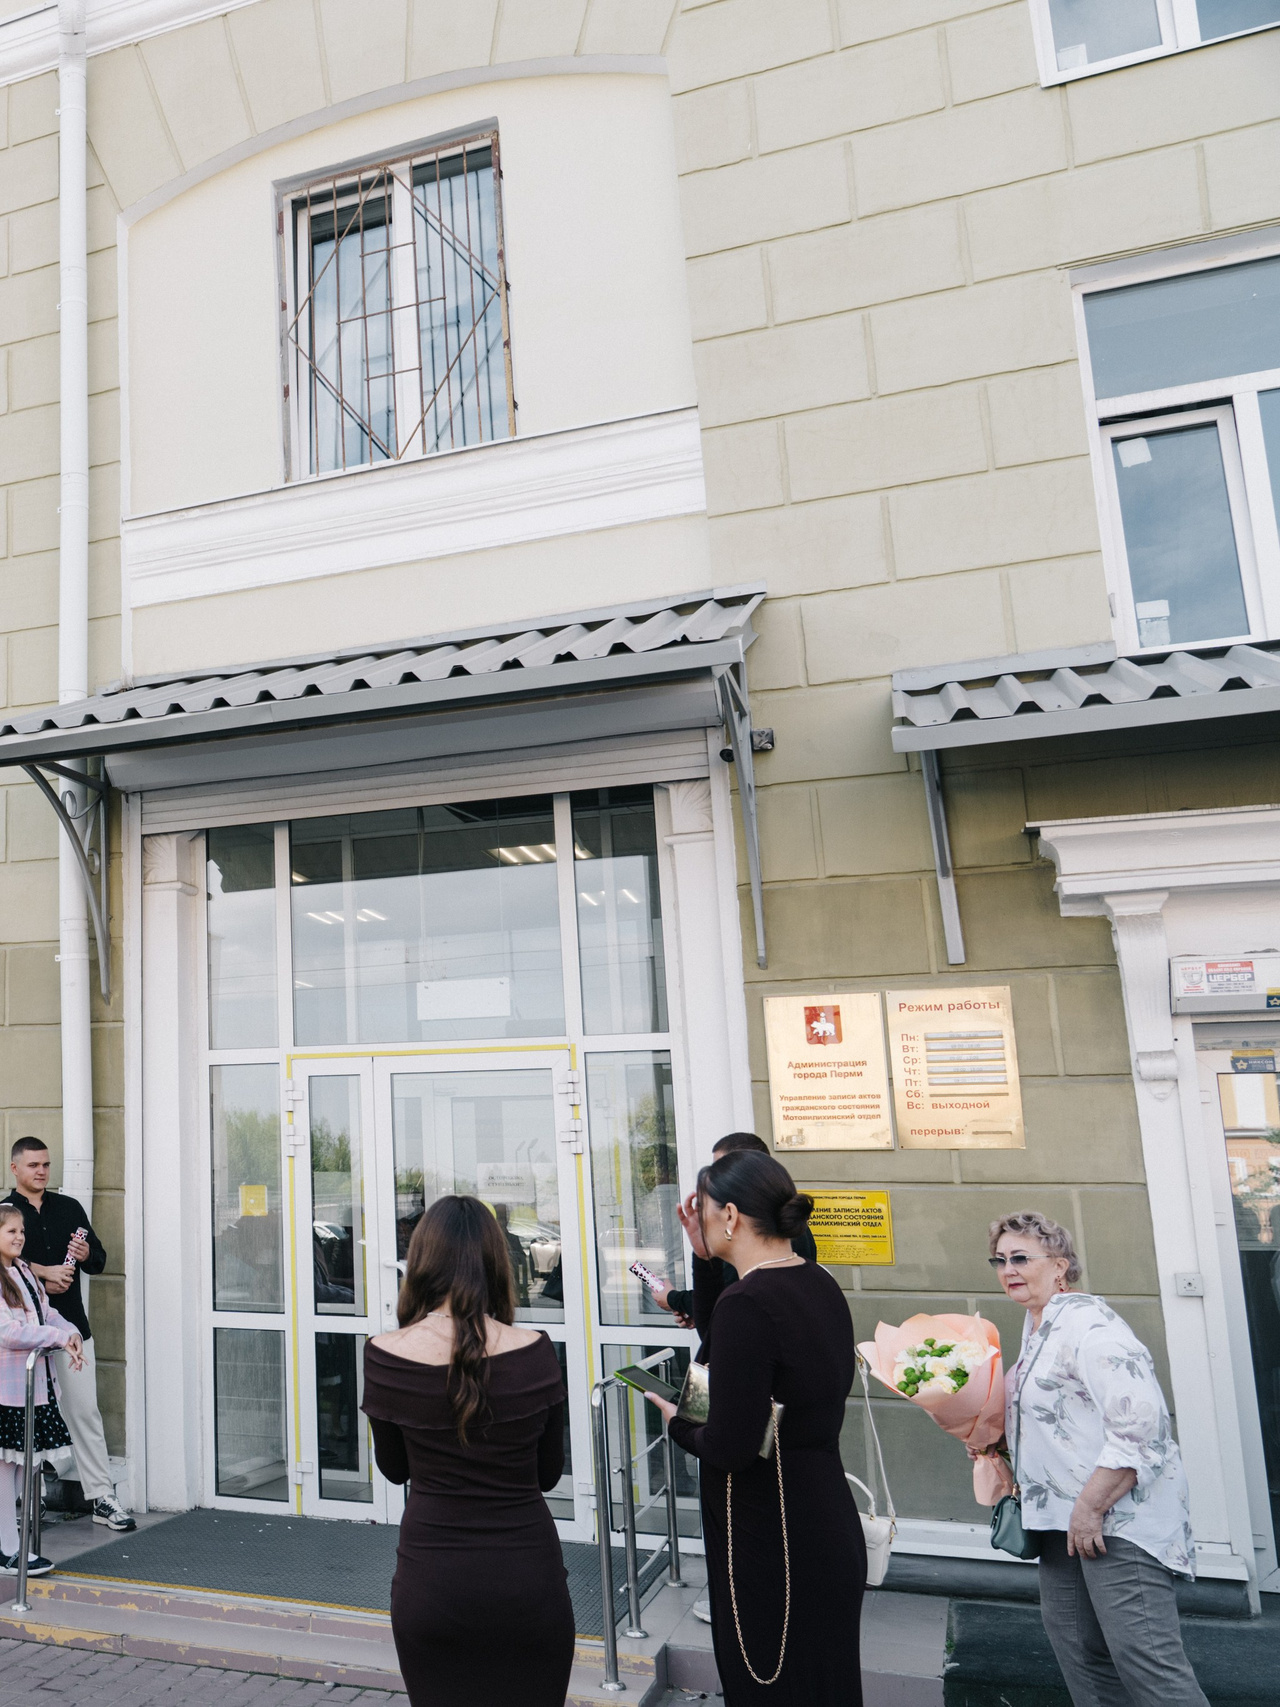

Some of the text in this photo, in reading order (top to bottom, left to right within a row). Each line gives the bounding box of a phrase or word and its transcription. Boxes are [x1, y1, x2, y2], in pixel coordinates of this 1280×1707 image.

[1208, 973, 1252, 982] ЦЕРБЕР
[898, 1000, 1000, 1014] Режим работы
[901, 1033, 919, 1042] Пн:
[902, 1044, 919, 1053] Вт:
[788, 1059, 868, 1070] Администрация
[903, 1056, 921, 1066] Ср:
[793, 1070, 863, 1080] города Перми
[904, 1068, 921, 1076] Чт:
[905, 1078, 922, 1086] Пт:
[906, 1089, 924, 1098] Сб:
[907, 1100, 990, 1110] Вс: выходной
[910, 1127, 965, 1136] перерыв:
